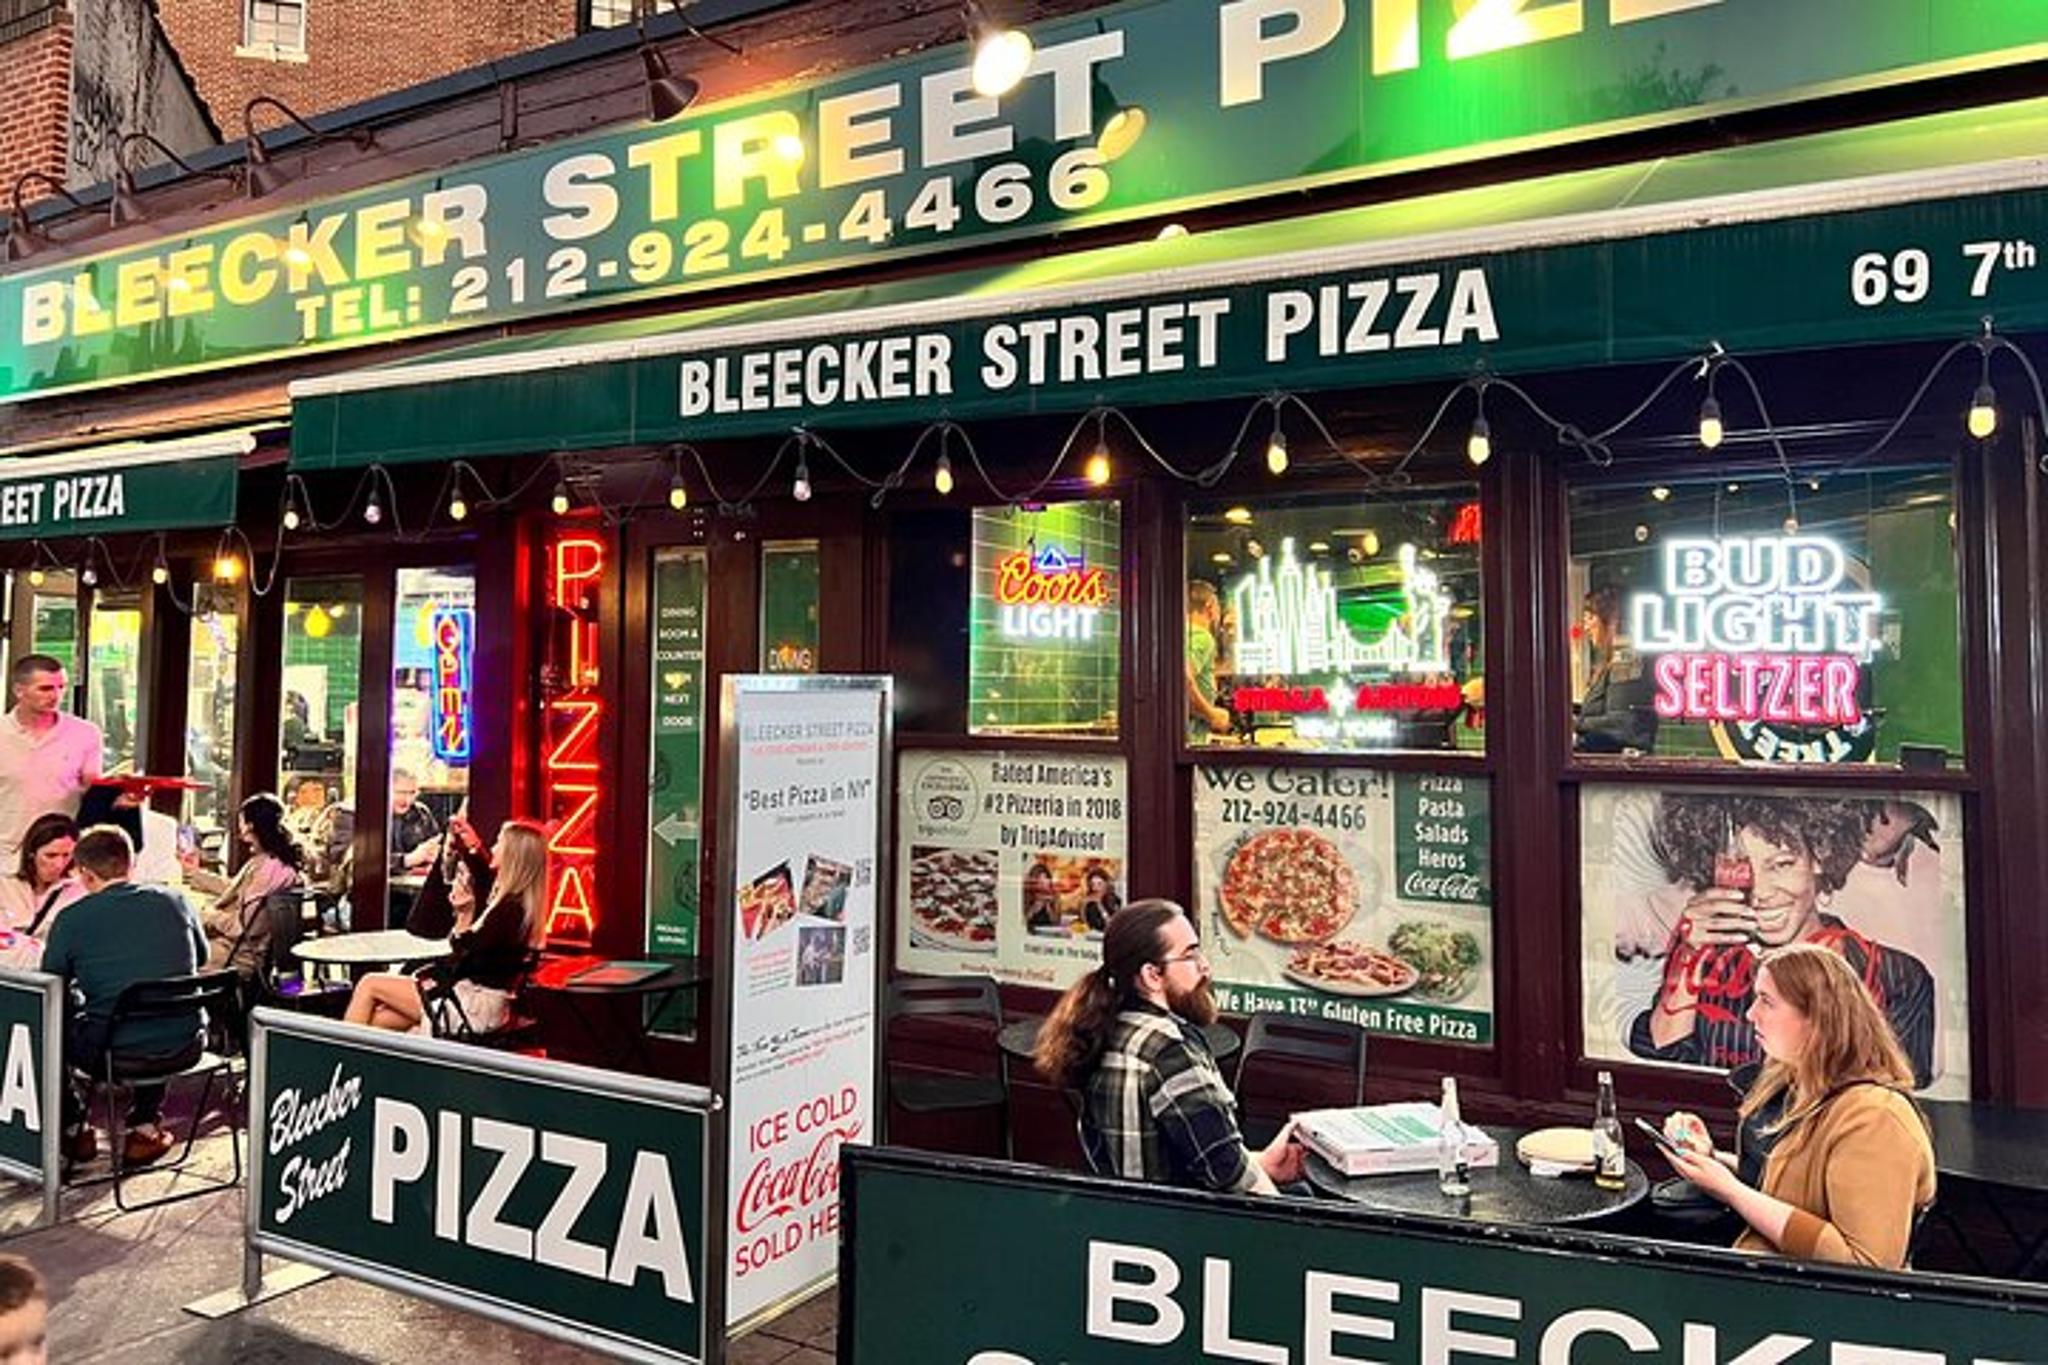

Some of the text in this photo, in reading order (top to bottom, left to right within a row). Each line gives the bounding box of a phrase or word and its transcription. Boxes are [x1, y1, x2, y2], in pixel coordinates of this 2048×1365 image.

[21, 185, 488, 347] BLEECKER
[542, 30, 1124, 241] STREET
[295, 147, 1110, 340] TEL: 212-924-4466
[1851, 239, 2037, 307] 69 7th
[680, 268, 1499, 418] BLEECKER STREET PIZZA
[53, 473, 124, 522] PIZZA
[997, 553, 1110, 605] Coors
[1663, 535, 1845, 596] BUD
[1002, 605, 1100, 640] LIGHT
[1631, 592, 1884, 652] LIGHT
[1654, 653, 1862, 726] SELTZER
[546, 537, 602, 936] PIZZA
[788, 785, 828, 806] Pizza
[830, 782, 845, 801] in
[991, 761, 1113, 788] Rated America's
[1266, 767, 1389, 799] Cater!
[1420, 776, 1463, 793] Pizza
[1006, 793, 1064, 817] Pizzeria
[1066, 797, 1083, 818] in
[1086, 799, 1122, 819] 2018
[1222, 798, 1367, 831] 212-924-4466
[1414, 821, 1469, 844] Salads
[1418, 797, 1465, 818] Pasta
[1001, 824, 1106, 851] by TripAdvisor
[1418, 847, 1466, 870] Heros
[1214, 987, 1240, 1011] We
[1322, 1000, 1381, 1028] Gluten
[1386, 1008, 1424, 1033] Free
[1429, 1013, 1478, 1040] Pizza
[269, 1062, 362, 1155] Bleecker
[750, 1087, 857, 1153] ICE COLD
[275, 1137, 351, 1223] Street
[371, 1096, 694, 1304] PIZZA
[735, 1201, 841, 1278] SOLD HE
